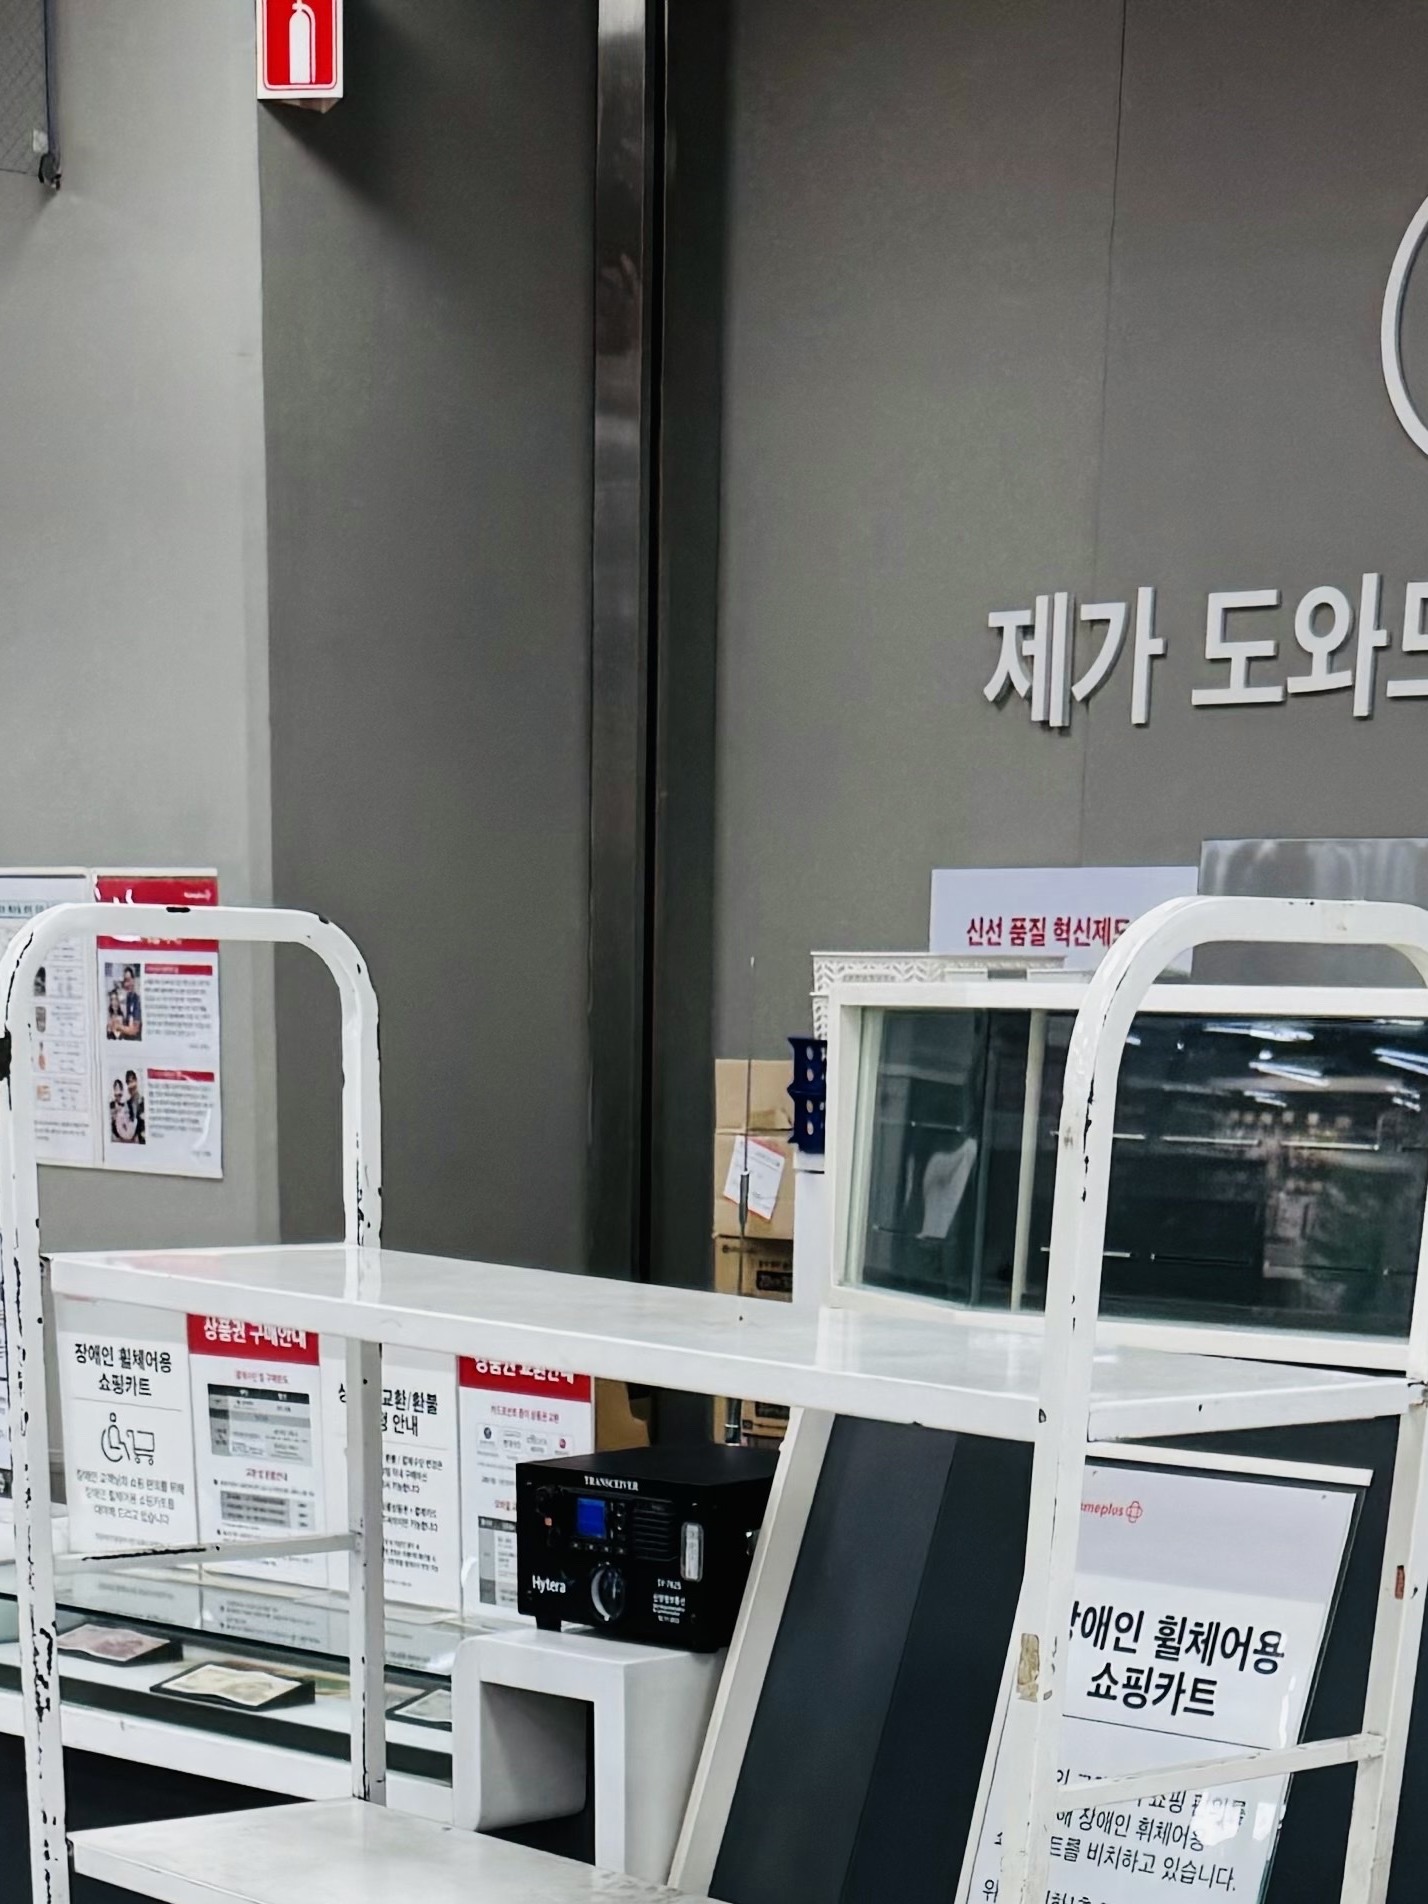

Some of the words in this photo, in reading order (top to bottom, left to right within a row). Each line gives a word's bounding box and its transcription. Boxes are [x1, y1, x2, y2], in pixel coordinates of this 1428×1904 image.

[983, 586, 1165, 728] 제가
[966, 916, 1003, 947] 신선
[1009, 916, 1047, 947] 품질
[74, 1343, 114, 1368] 장애인
[99, 1372, 152, 1397] 쇼핑카트
[392, 1414, 420, 1437] 안내
[584, 1474, 640, 1492] TRANSCEIVER
[532, 1574, 567, 1595] Hytera
[1153, 1614, 1286, 1676] 휠체어용
[1086, 1661, 1219, 1718] 쇼핑카트
[1086, 1841, 1156, 1875] 비치하고
[1161, 1856, 1237, 1892] 있습니다.
